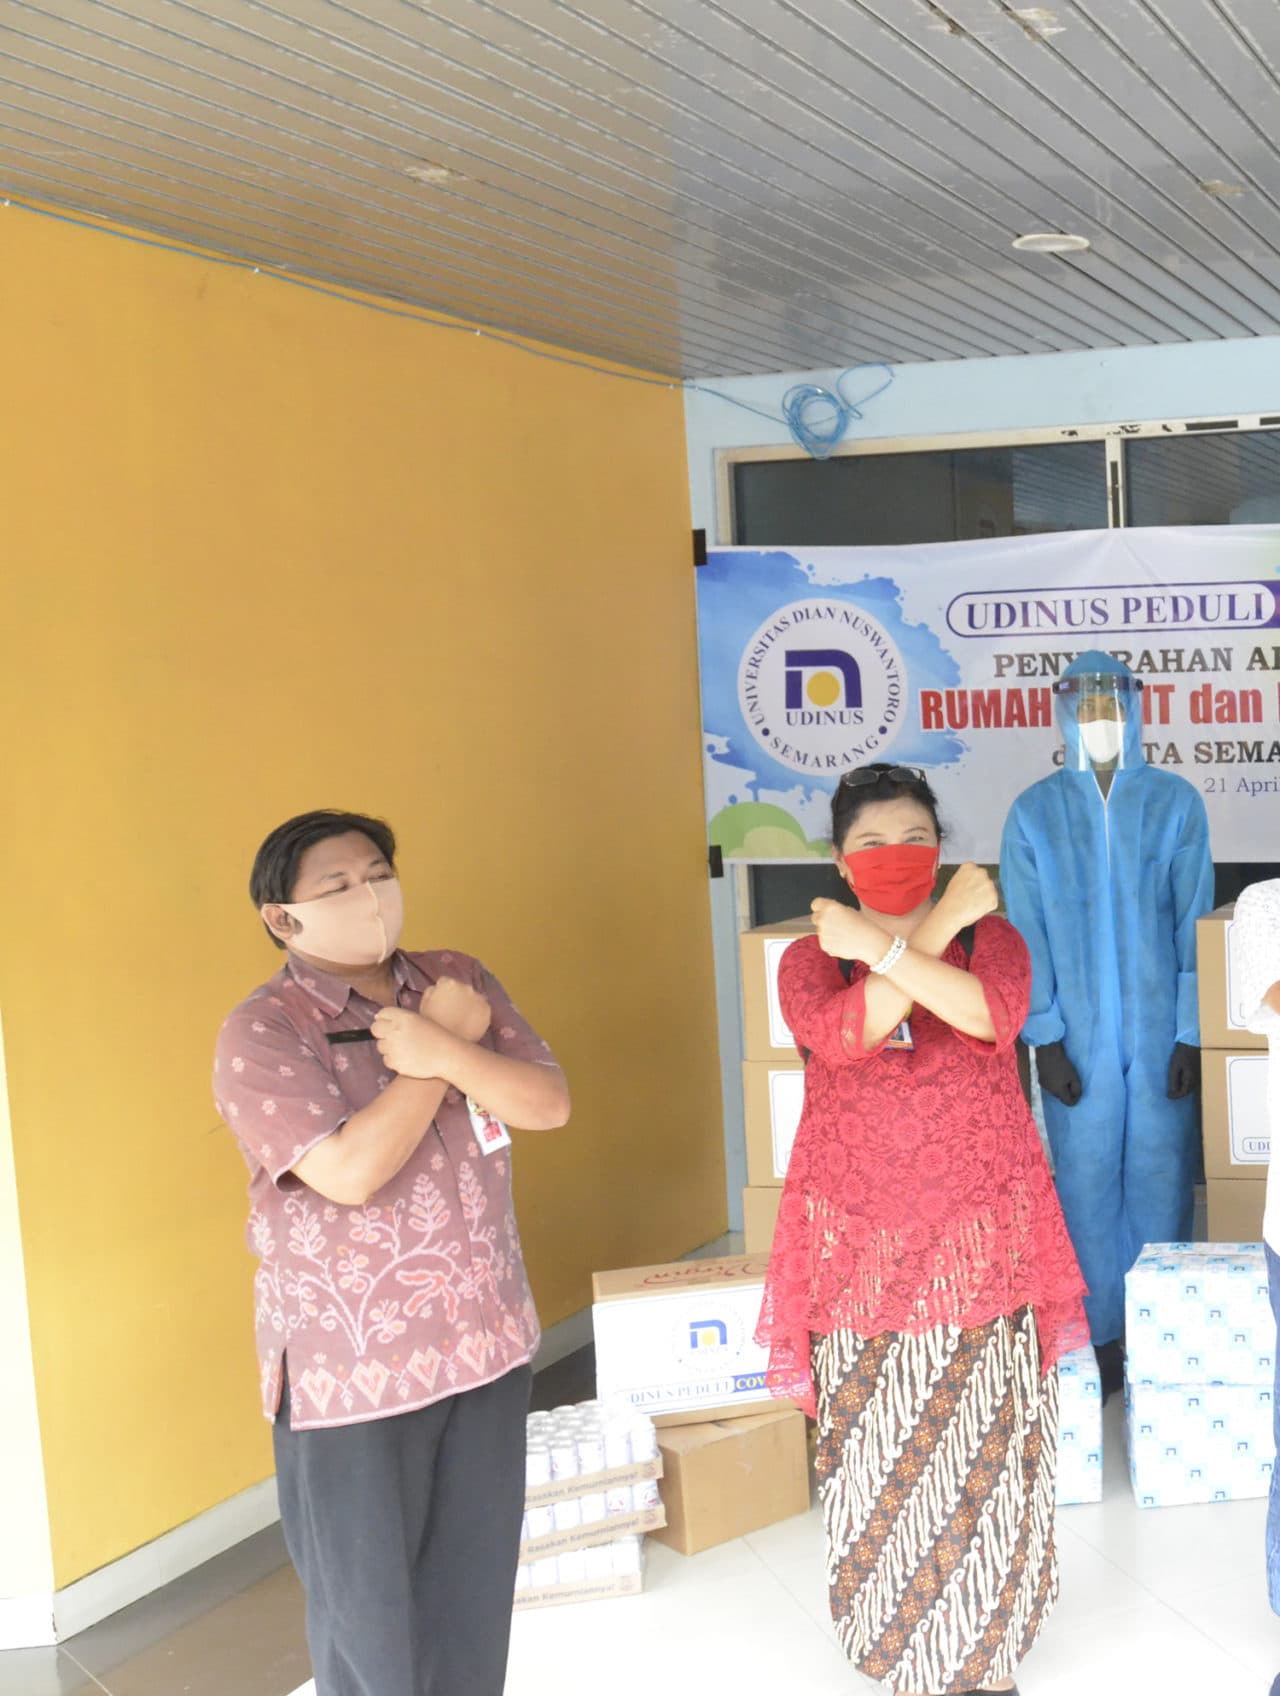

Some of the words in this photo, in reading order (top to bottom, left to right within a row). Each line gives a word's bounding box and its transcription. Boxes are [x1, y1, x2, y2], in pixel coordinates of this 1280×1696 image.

[967, 598, 1109, 630] UDINUS
[1120, 592, 1265, 625] PEDULI
[745, 616, 791, 726] UNIVERSITAS
[792, 607, 837, 624] DIAN
[840, 610, 901, 723] NUSWANTORO
[993, 647, 1233, 678] PENYRAHAN
[785, 710, 864, 726] UDINUS
[920, 687, 1052, 730] RUMAH
[1189, 683, 1263, 724] dan
[770, 735, 880, 768] SEMARANG
[1203, 777, 1228, 793] 21
[1249, 1140, 1271, 1152] UDI
[630, 1389, 674, 1403] DINUS
